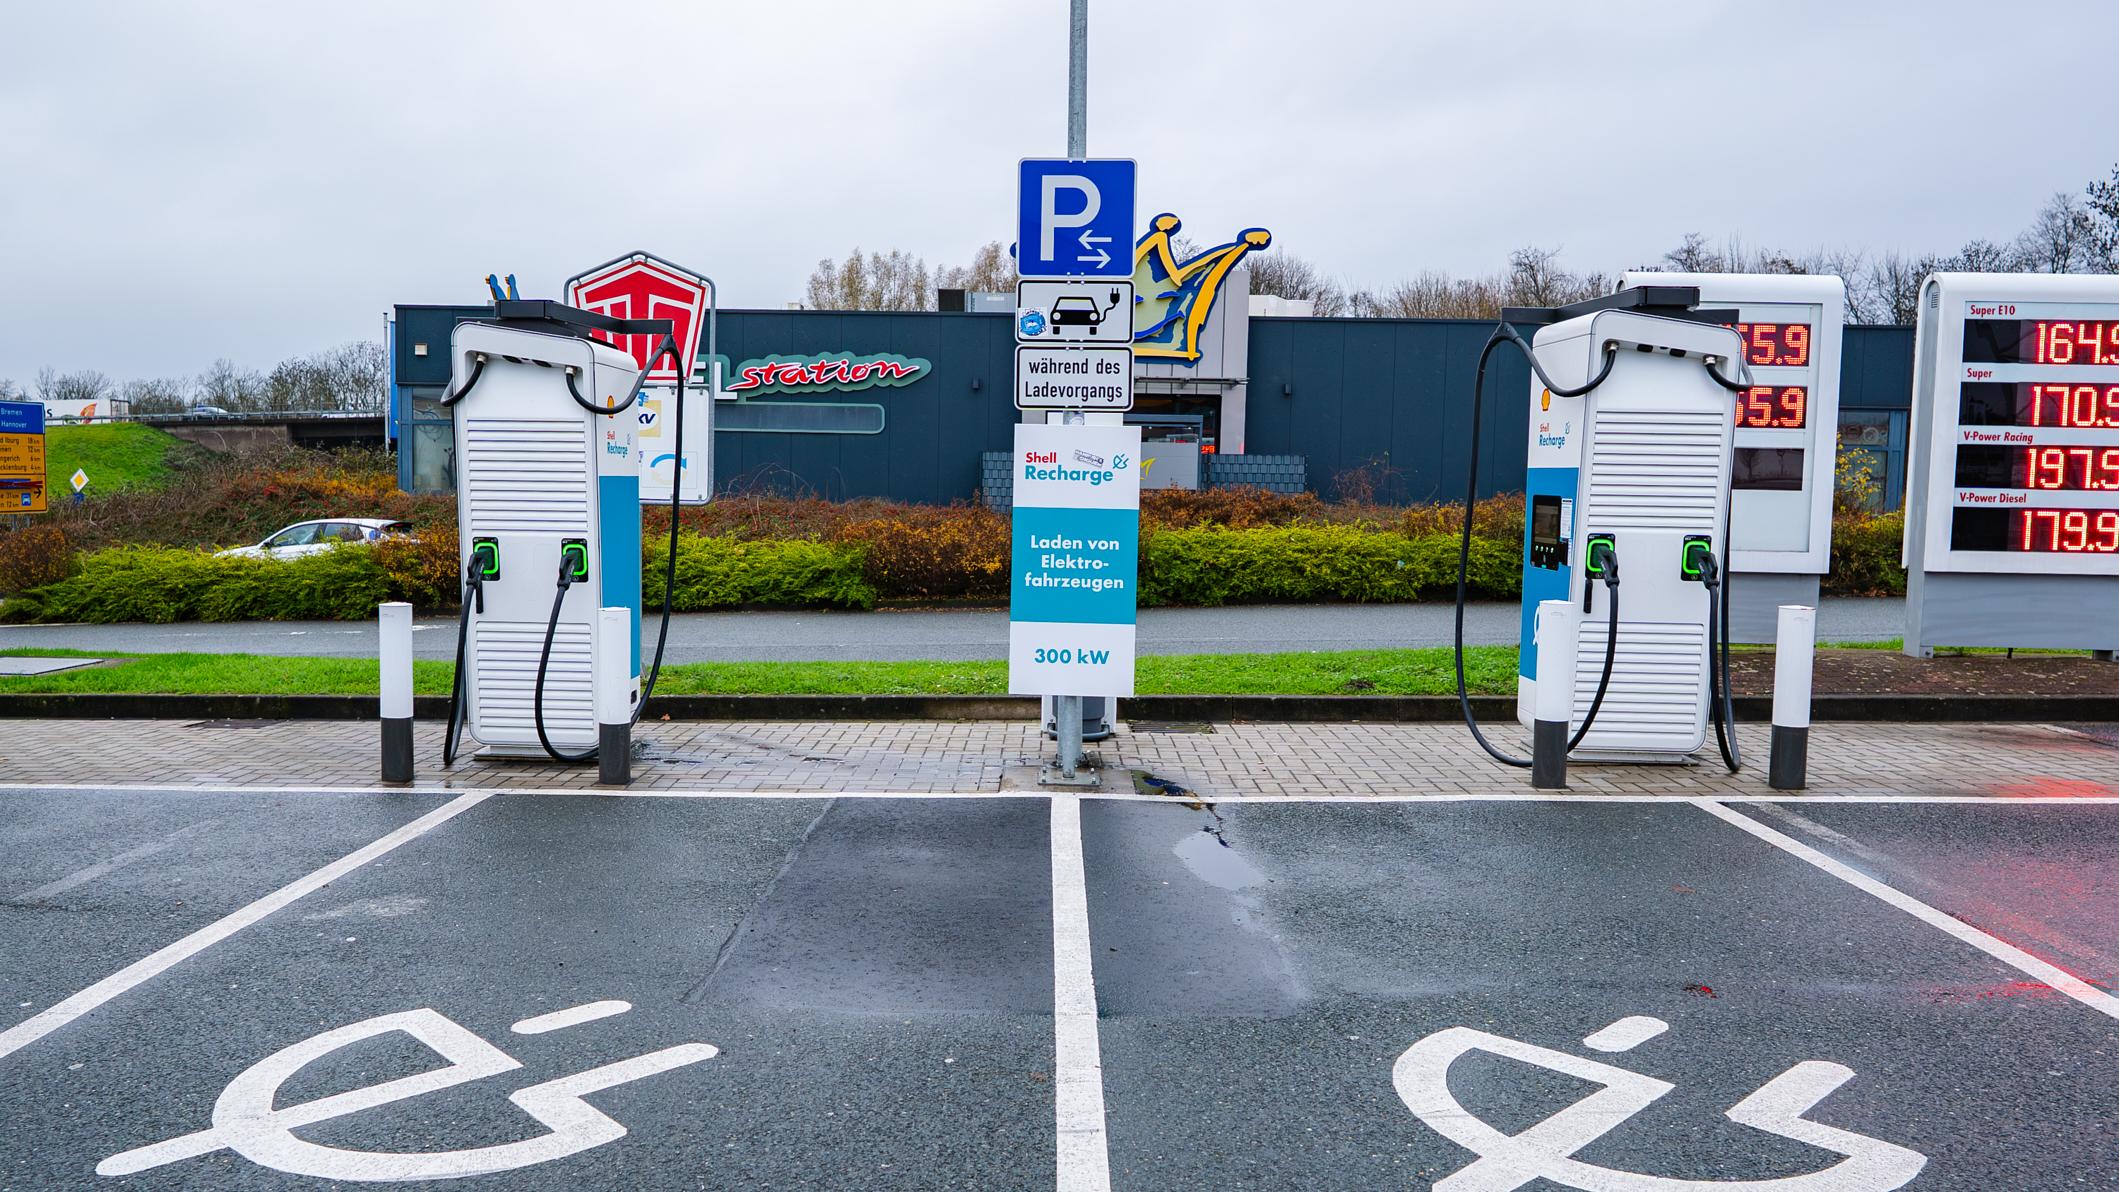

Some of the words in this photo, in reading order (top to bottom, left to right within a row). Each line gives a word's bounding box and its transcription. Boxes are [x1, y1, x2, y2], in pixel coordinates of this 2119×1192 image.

[1040, 174, 1102, 262] P
[1970, 304, 1996, 318] Super
[1998, 304, 2016, 316] E10
[1028, 357, 1089, 375] während
[1095, 358, 1121, 375] des
[1967, 367, 1993, 381] Super
[726, 359, 921, 391] station
[1025, 381, 1123, 402] Ladevorgangs
[0, 407, 23, 416] Bremen
[1, 420, 27, 428] Hannover
[1540, 423, 1550, 433] Shell
[1538, 434, 1566, 449] Recharge
[1963, 431, 2001, 441] V-Power
[2003, 431, 2034, 445] Racing
[1025, 451, 1057, 464] Shell
[1024, 464, 1114, 486] Recharge
[2028, 448, 2119, 490] 197.9
[1960, 492, 1997, 503] V-Power
[1999, 493, 2027, 503] Diesel
[2024, 511, 2119, 552] 179.9
[1030, 534, 1083, 551] Laden
[1088, 538, 1120, 551] von
[1041, 554, 1109, 571] Elektro-
[1024, 572, 1124, 592] fahrzeugen
[1034, 648, 1072, 664] 300
[1077, 648, 1110, 665] kW
